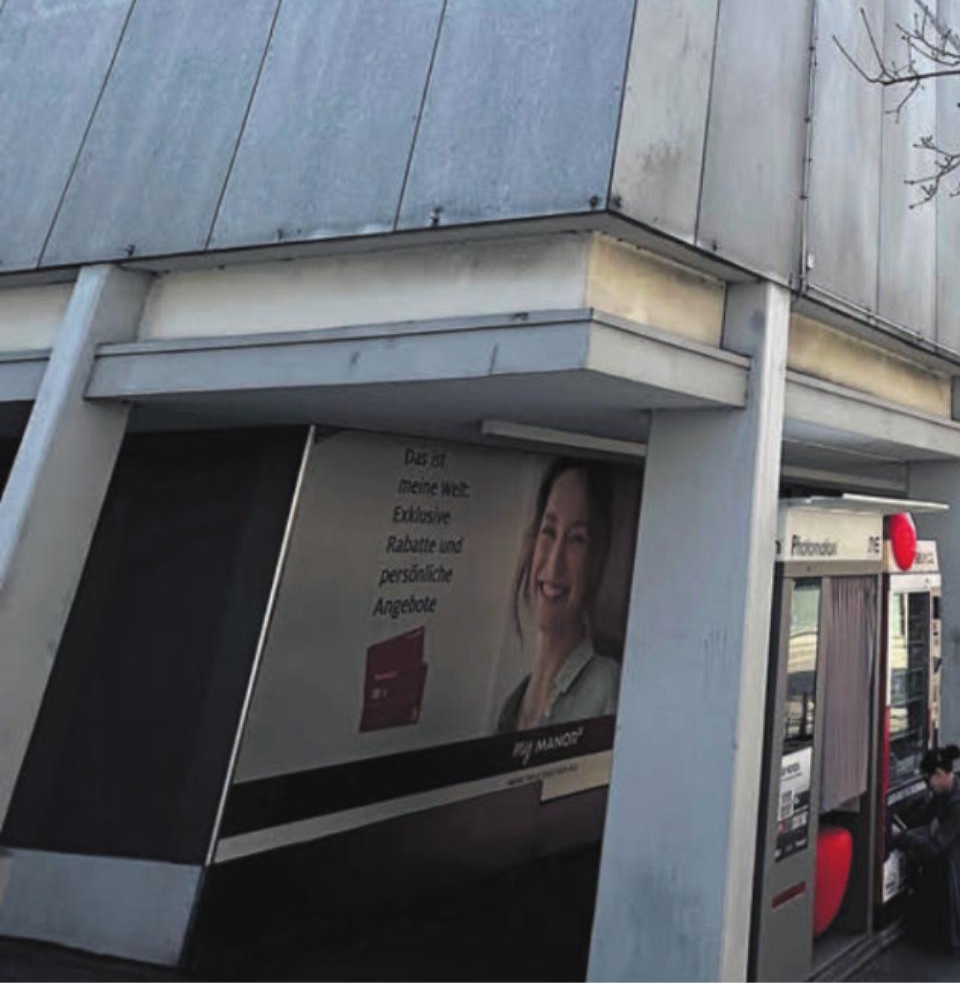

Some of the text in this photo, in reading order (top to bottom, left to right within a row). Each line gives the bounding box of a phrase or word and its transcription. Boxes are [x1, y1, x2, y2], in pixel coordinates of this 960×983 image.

[404, 447, 447, 468] Das ist
[398, 479, 438, 496] meine
[392, 505, 451, 524] Exklusive
[386, 535, 463, 554] Rabatte und
[379, 564, 453, 587] persönliche
[372, 595, 438, 619] Angebote
[534, 731, 578, 753] MANOR
